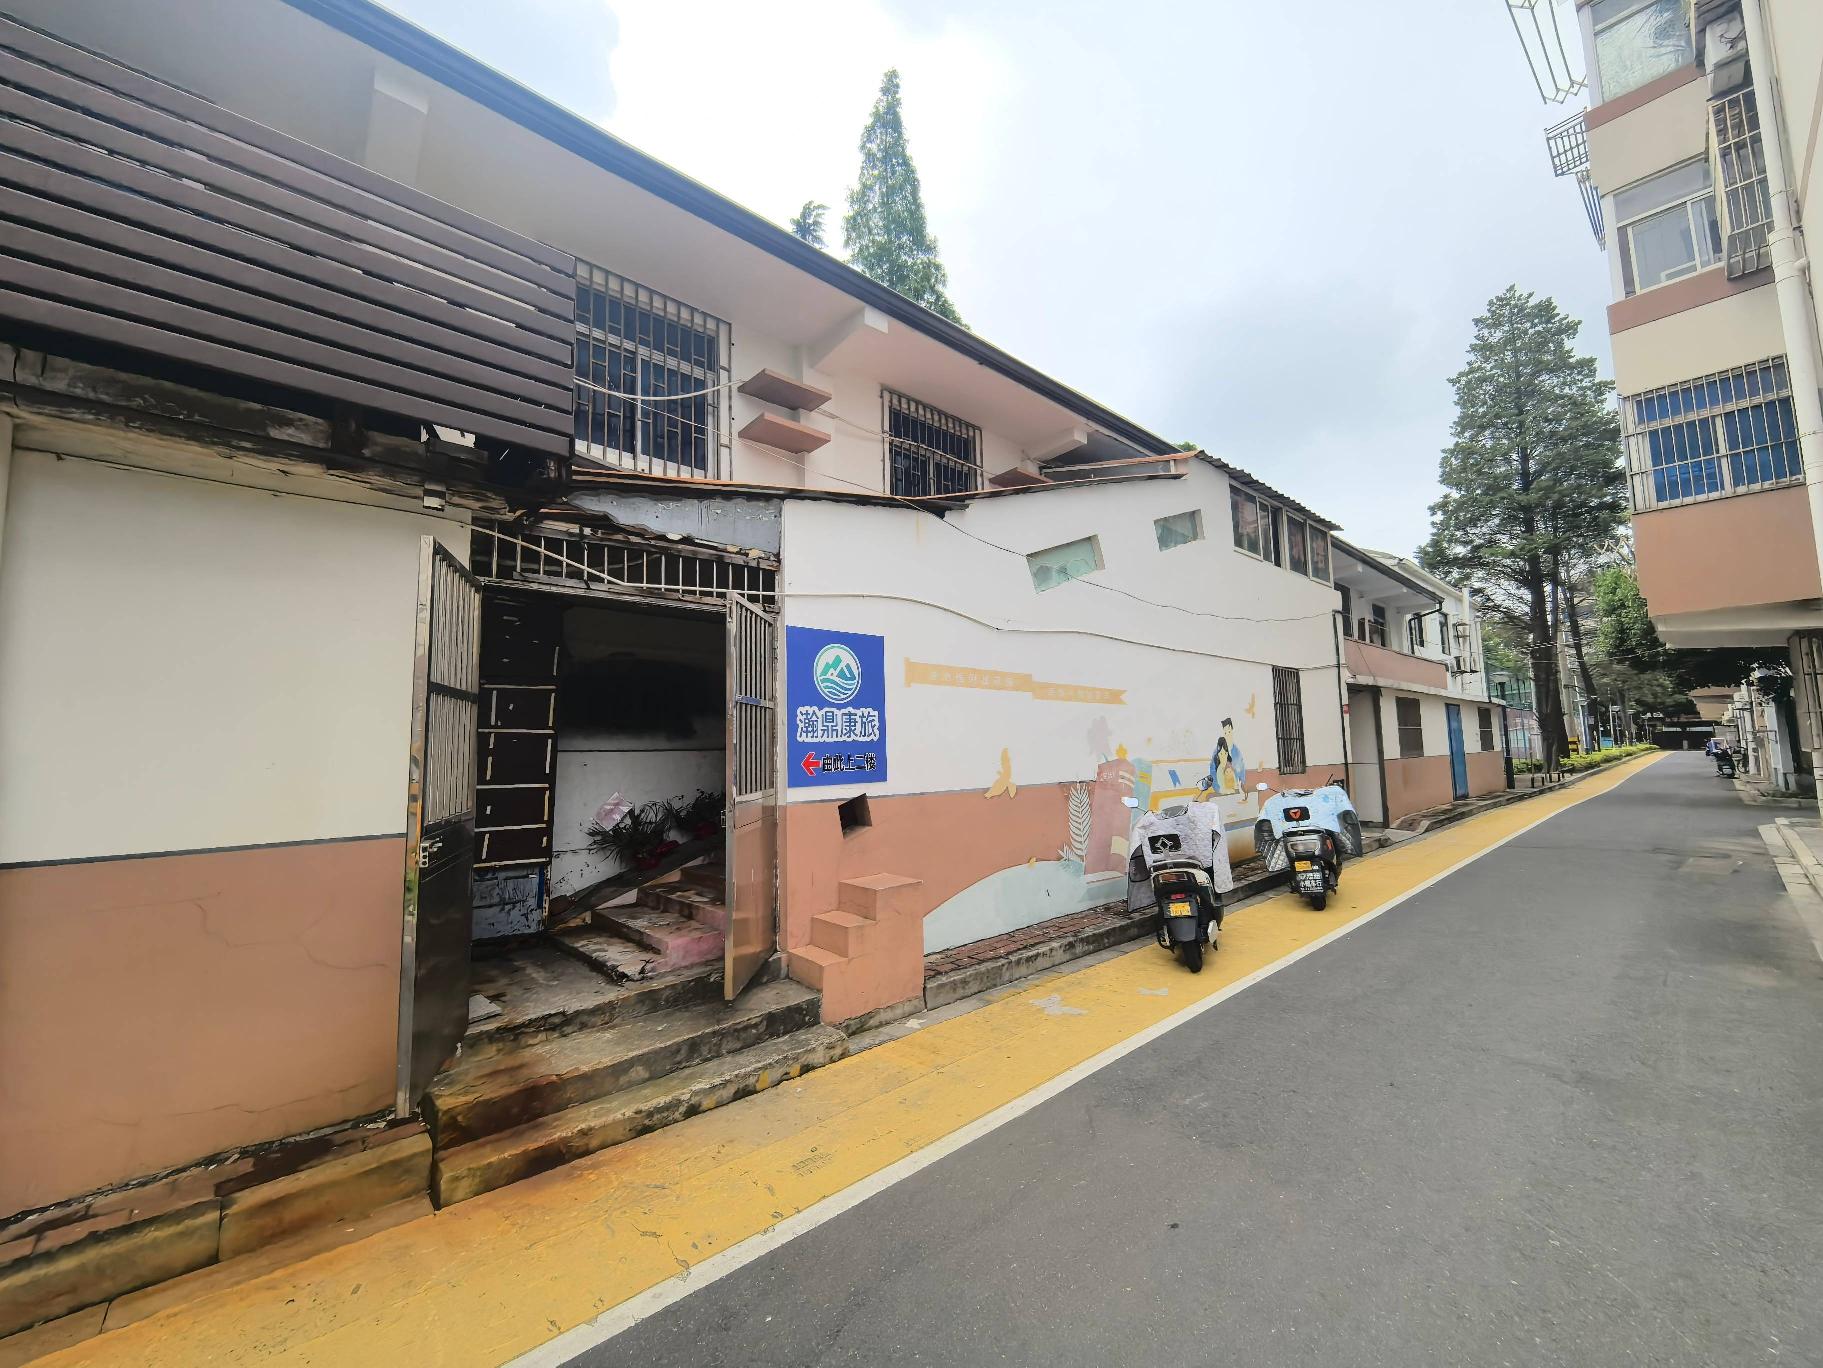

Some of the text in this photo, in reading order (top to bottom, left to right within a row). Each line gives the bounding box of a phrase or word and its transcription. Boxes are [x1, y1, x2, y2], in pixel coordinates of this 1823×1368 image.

[798, 708, 878, 740] 瀚鼎康旅
[822, 753, 876, 772] 由此上二楼
